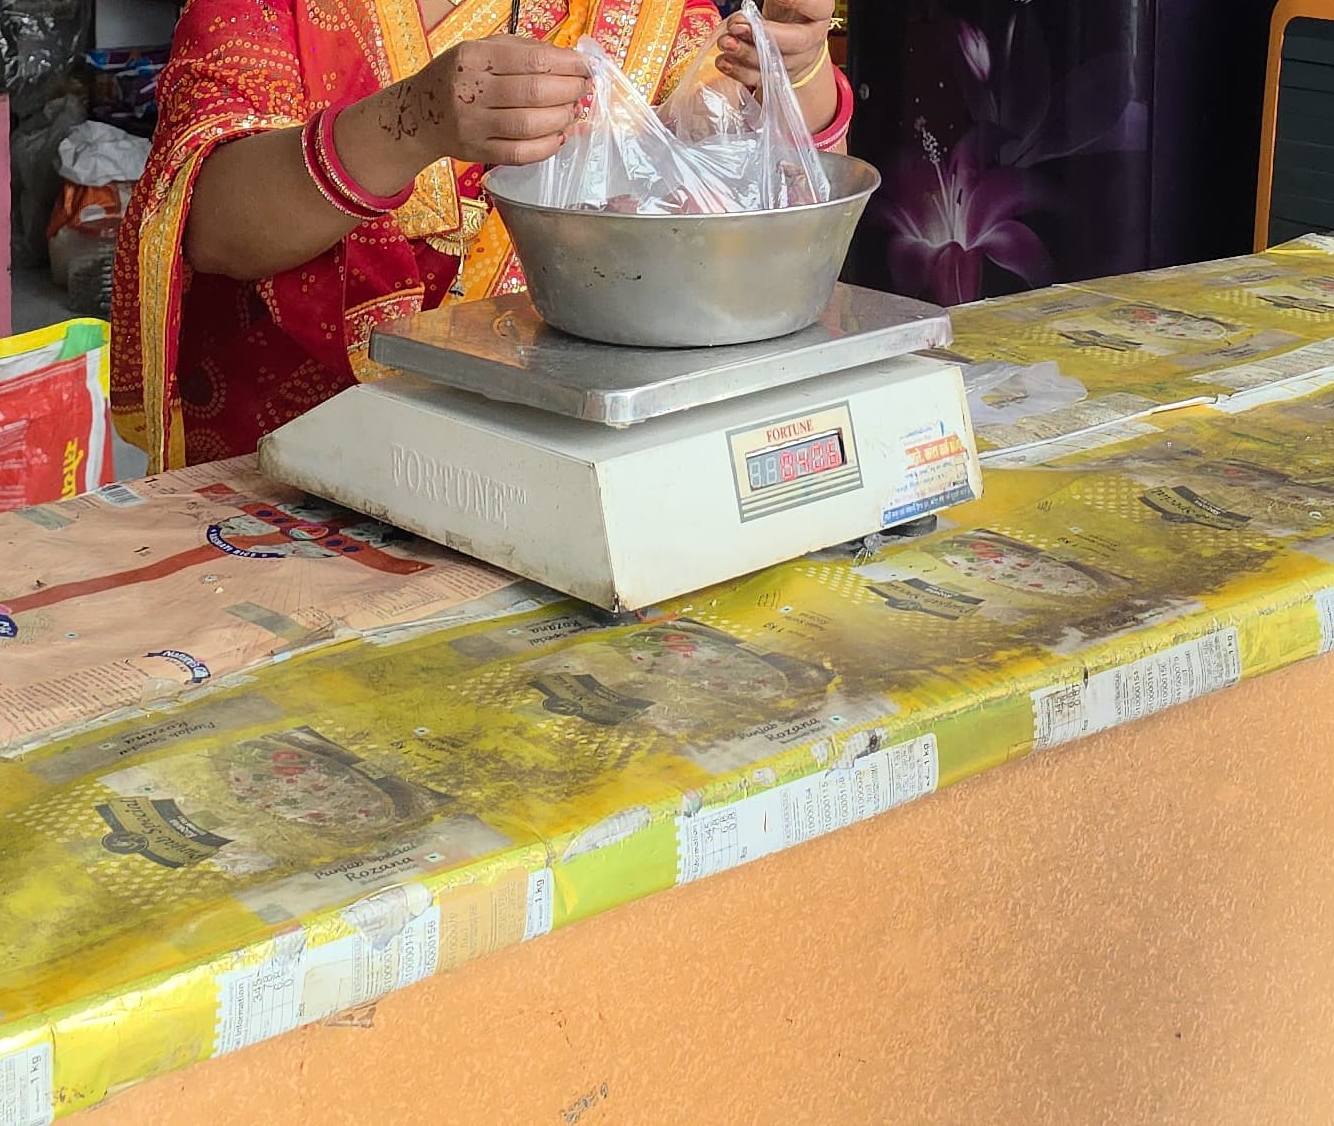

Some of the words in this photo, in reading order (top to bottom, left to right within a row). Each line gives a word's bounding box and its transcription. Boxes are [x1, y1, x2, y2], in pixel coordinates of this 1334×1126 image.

[766, 418, 814, 443] FORTUNE
[391, 440, 509, 531] FORTUNE
[767, 717, 821, 742] Rozana
[314, 860, 364, 880] Punjab
[345, 856, 416, 882] Rozana
[535, 877, 547, 896] kg
[235, 981, 245, 1040] Information
[29, 1054, 43, 1074] kg
